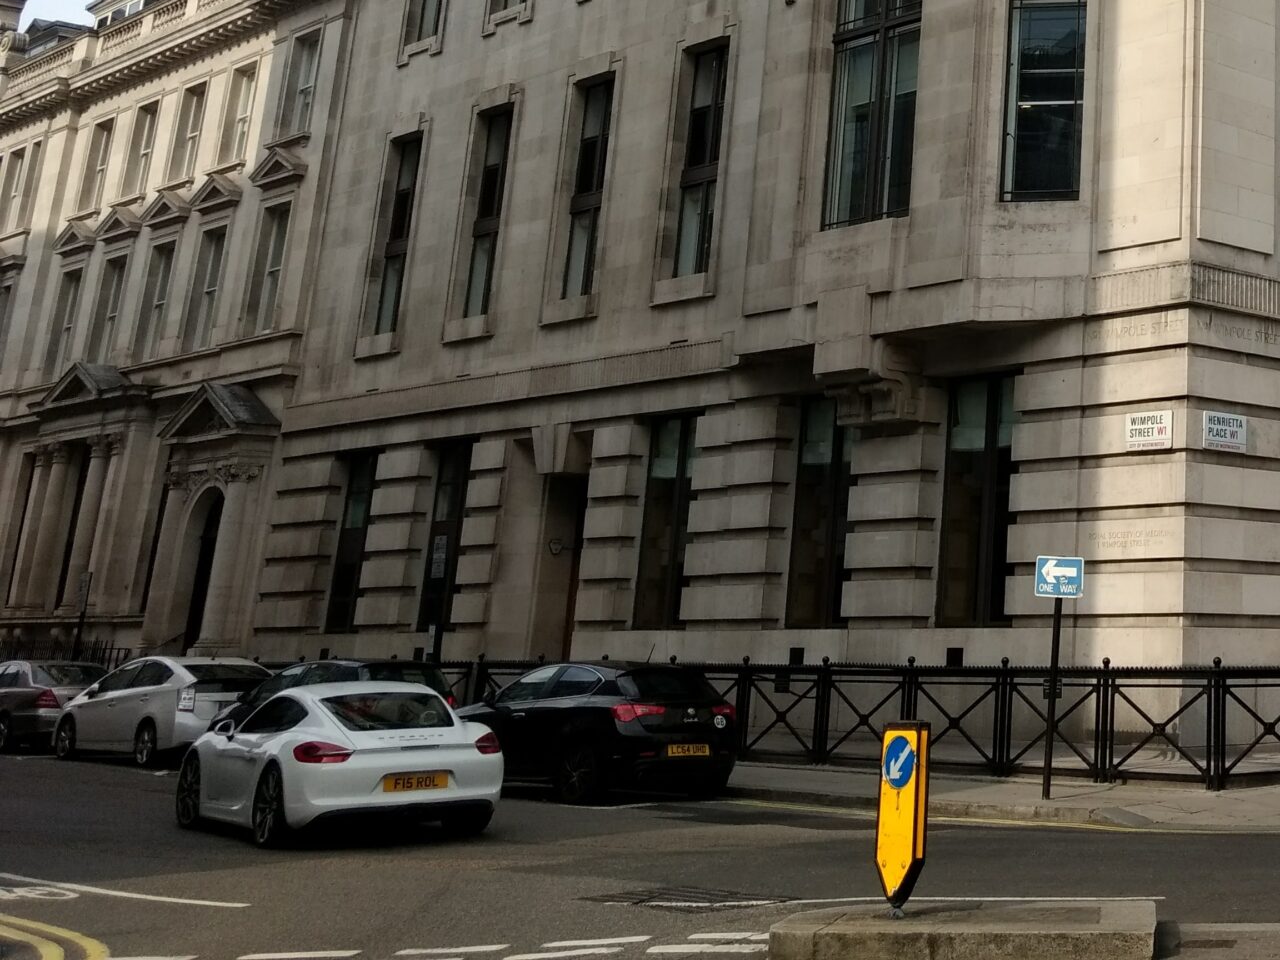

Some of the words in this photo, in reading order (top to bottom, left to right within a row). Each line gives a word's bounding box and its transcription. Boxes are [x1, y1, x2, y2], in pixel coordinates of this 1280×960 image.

[1130, 414, 1163, 427] WIMPOLE
[1208, 414, 1243, 430] HENRIETTA
[1129, 426, 1155, 439] STREET
[1156, 425, 1167, 436] W1
[1207, 426, 1228, 439] PLACE
[1229, 429, 1239, 440] W1
[1038, 583, 1054, 593] ONE
[1059, 584, 1078, 593] WAY
[715, 716, 725, 727] GB
[671, 745, 691, 755] LC64
